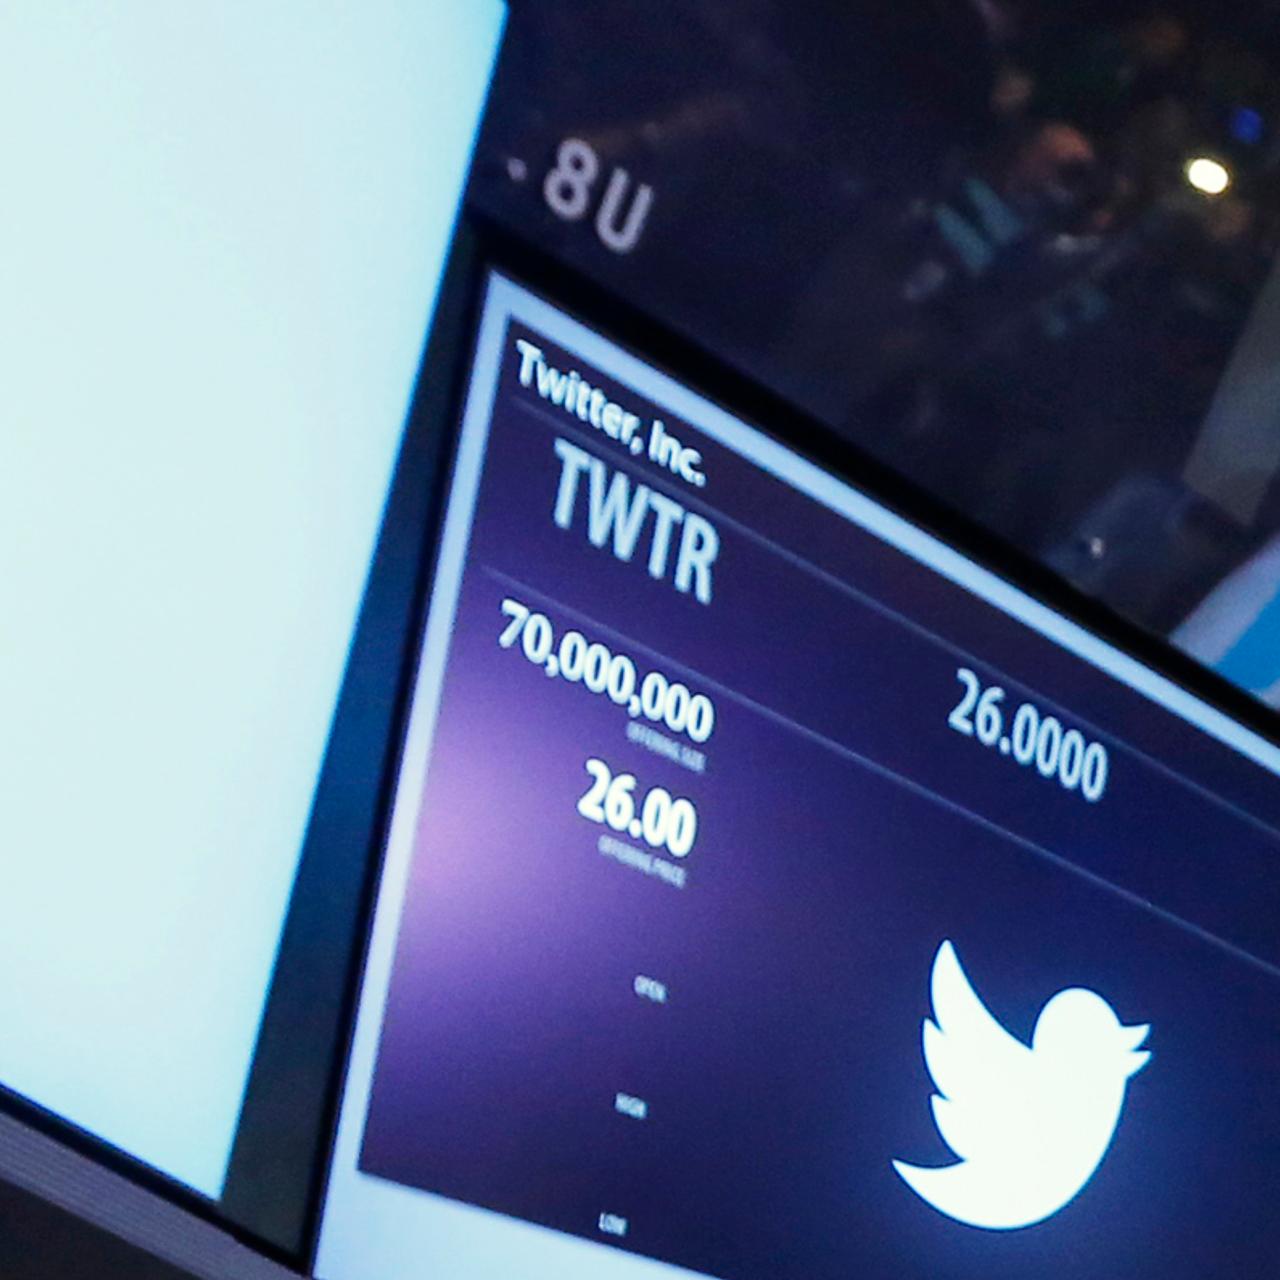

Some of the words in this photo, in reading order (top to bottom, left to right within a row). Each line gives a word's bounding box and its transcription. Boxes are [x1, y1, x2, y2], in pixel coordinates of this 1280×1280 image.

[516, 338, 644, 456] Twitter,
[648, 419, 707, 488] Inc.
[553, 436, 721, 606] TWTR
[498, 598, 715, 743] 70,000,000
[948, 667, 1108, 803] 26.0000
[577, 757, 697, 859] 26.00
